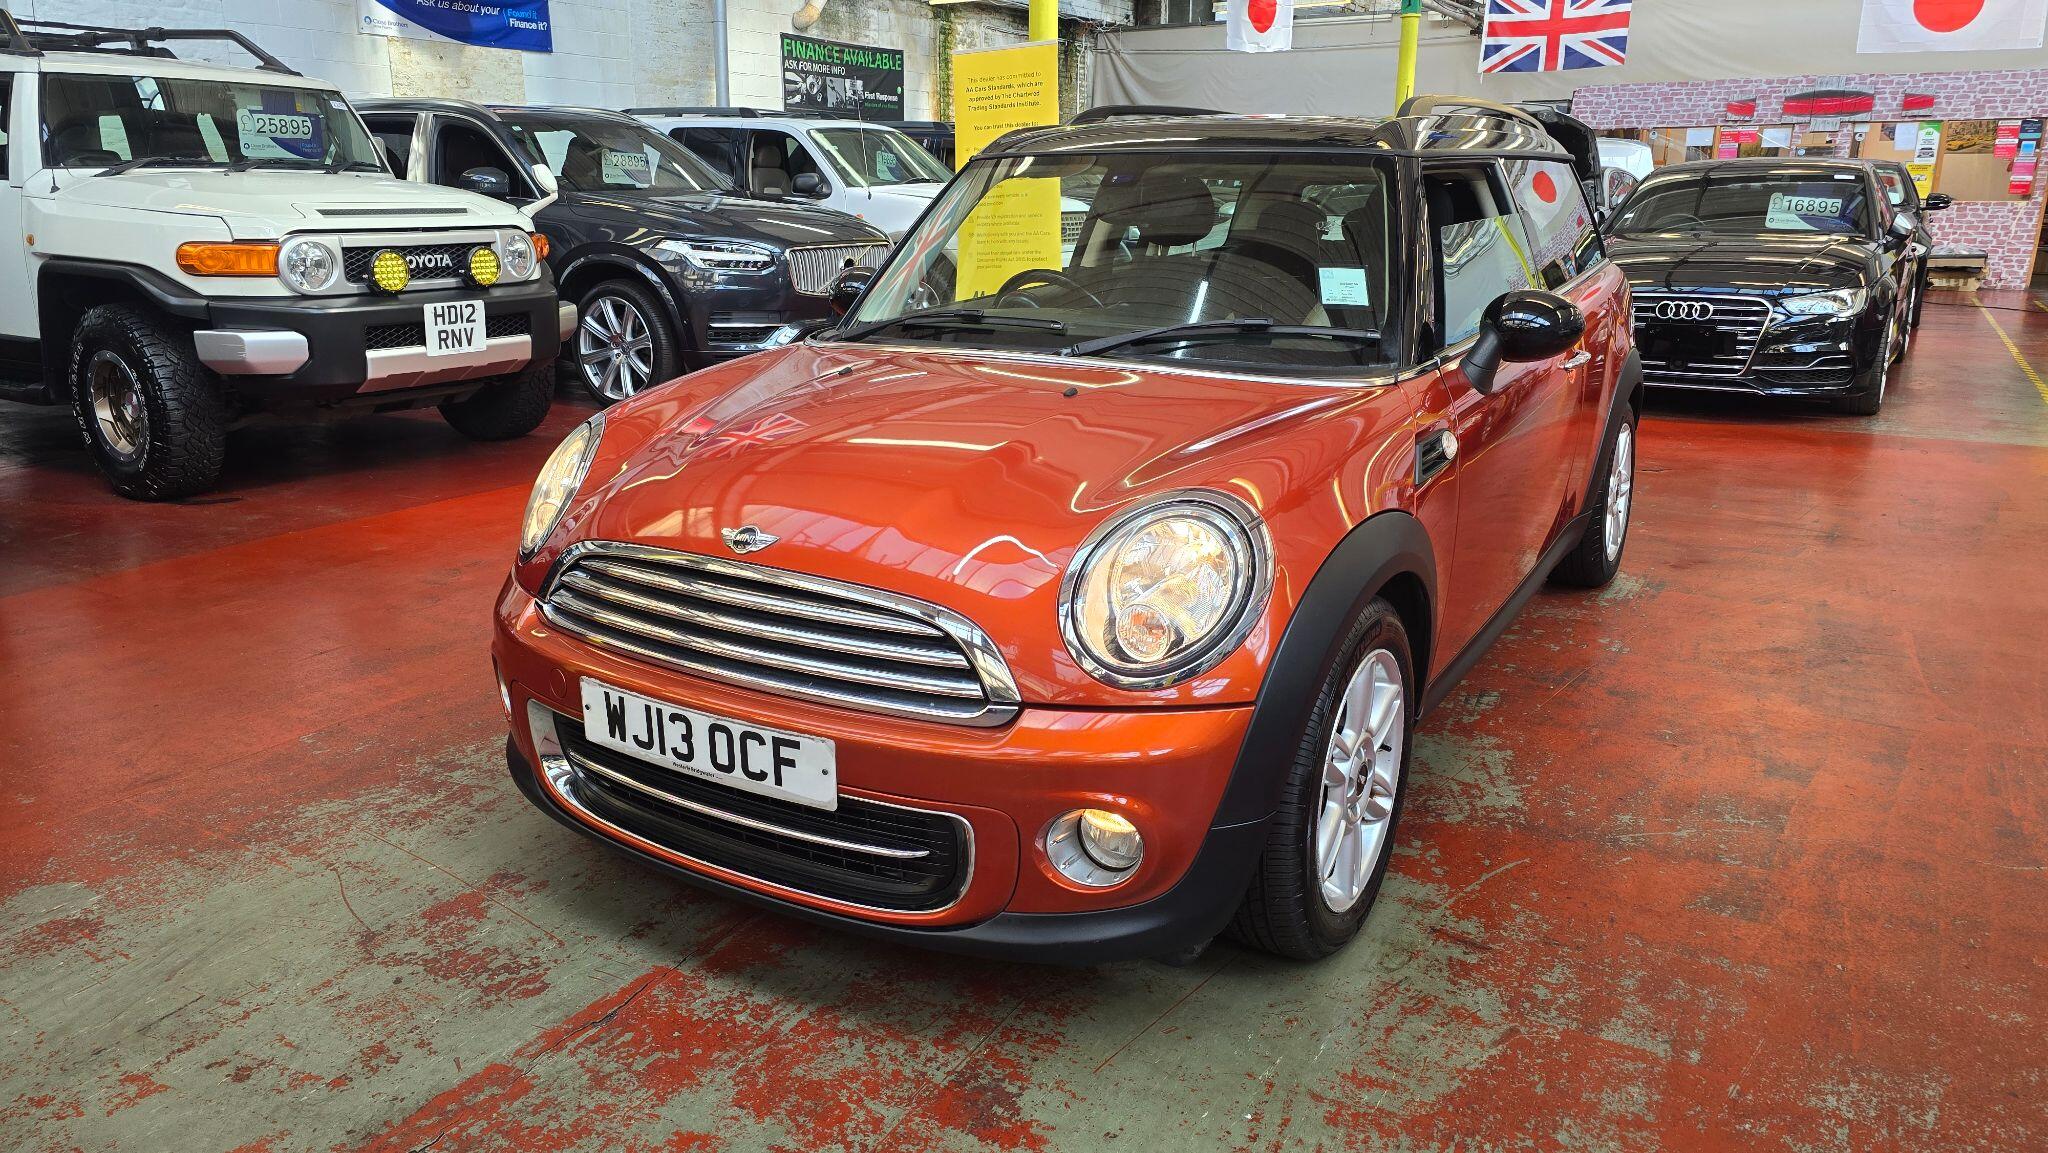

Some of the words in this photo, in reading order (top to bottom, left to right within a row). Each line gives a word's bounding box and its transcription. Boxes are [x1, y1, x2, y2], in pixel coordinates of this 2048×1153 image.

[437, 0, 450, 9] us
[451, 1, 479, 13] about
[480, 5, 500, 16] your
[507, 9, 529, 18] Found
[530, 10, 538, 19] it
[509, 18, 538, 30] Finance
[537, 20, 548, 31] it?
[783, 38, 841, 64] FINANCE
[843, 48, 902, 71] AVAILABLE
[784, 59, 798, 70] ASK
[798, 61, 812, 72] FOR
[812, 64, 831, 74] MORE
[831, 66, 846, 76] INFO
[1006, 72, 1035, 80] committed
[987, 83, 1016, 91] Standards,
[1016, 81, 1034, 89] which
[968, 95, 994, 103] approved
[1012, 90, 1040, 98] Chartered
[988, 102, 1016, 110] Standards
[256, 117, 311, 136] 25895
[1786, 199, 1839, 214] 16895
[405, 254, 453, 269] OYOTA
[433, 303, 477, 326] HD12
[437, 327, 474, 350] RNV
[604, 690, 695, 763] WJ13
[707, 722, 801, 787] OCF
